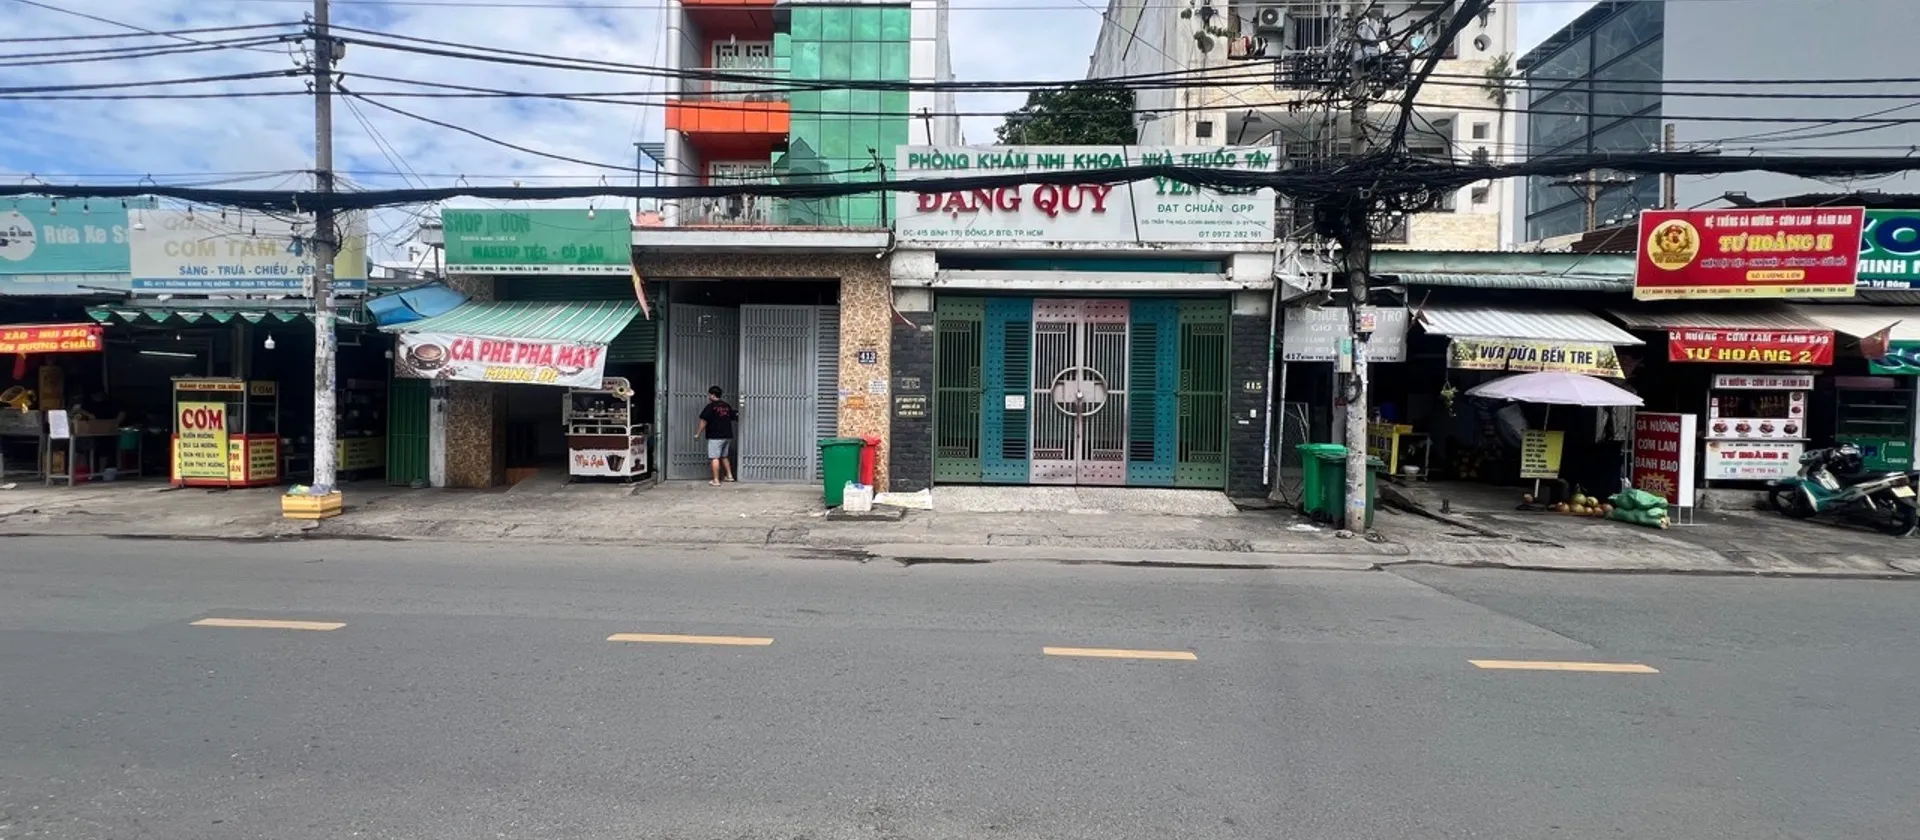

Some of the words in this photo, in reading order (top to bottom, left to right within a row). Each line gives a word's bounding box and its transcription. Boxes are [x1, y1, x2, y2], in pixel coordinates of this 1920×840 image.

[909, 149, 969, 168] PHÒNG
[977, 150, 1029, 169] KHÁM
[1037, 154, 1065, 169] NHI
[1073, 153, 1124, 169] KHOA
[1142, 149, 1174, 166] NHÀ
[1182, 147, 1236, 167] THUỐC
[1245, 150, 1272, 168] TÂY
[1231, 203, 1255, 213] GPP
[445, 212, 483, 232] SHOP
[1026, 229, 1044, 237] HCM
[1718, 232, 1747, 252] TƯ
[1747, 231, 1814, 252] HOÀNG
[472, 246, 520, 258] MAKEUP
[217, 264, 246, 276] TRƯA
[1886, 280, 1911, 289] Đông
[1726, 330, 1748, 342] CƠM
[1750, 332, 1772, 343] LAM
[1779, 332, 1806, 344] BÁNH
[860, 352, 876, 360] 413
[1508, 344, 1536, 361] DỪA
[1541, 346, 1565, 363] BẾN
[1570, 351, 1593, 365] TRE
[1685, 346, 1713, 360] TƯ
[1719, 345, 1792, 362] HOÀNG
[1799, 350, 1812, 363] 2
[1243, 381, 1262, 391] 415
[181, 405, 224, 430] CƠM
[1636, 418, 1647, 430] GÀ
[1649, 419, 1680, 433] NƯỚNG
[1637, 438, 1656, 451] CƠM
[1657, 440, 1677, 453] LAM
[1635, 455, 1658, 469] BÁNH
[1660, 459, 1678, 473] BAO
